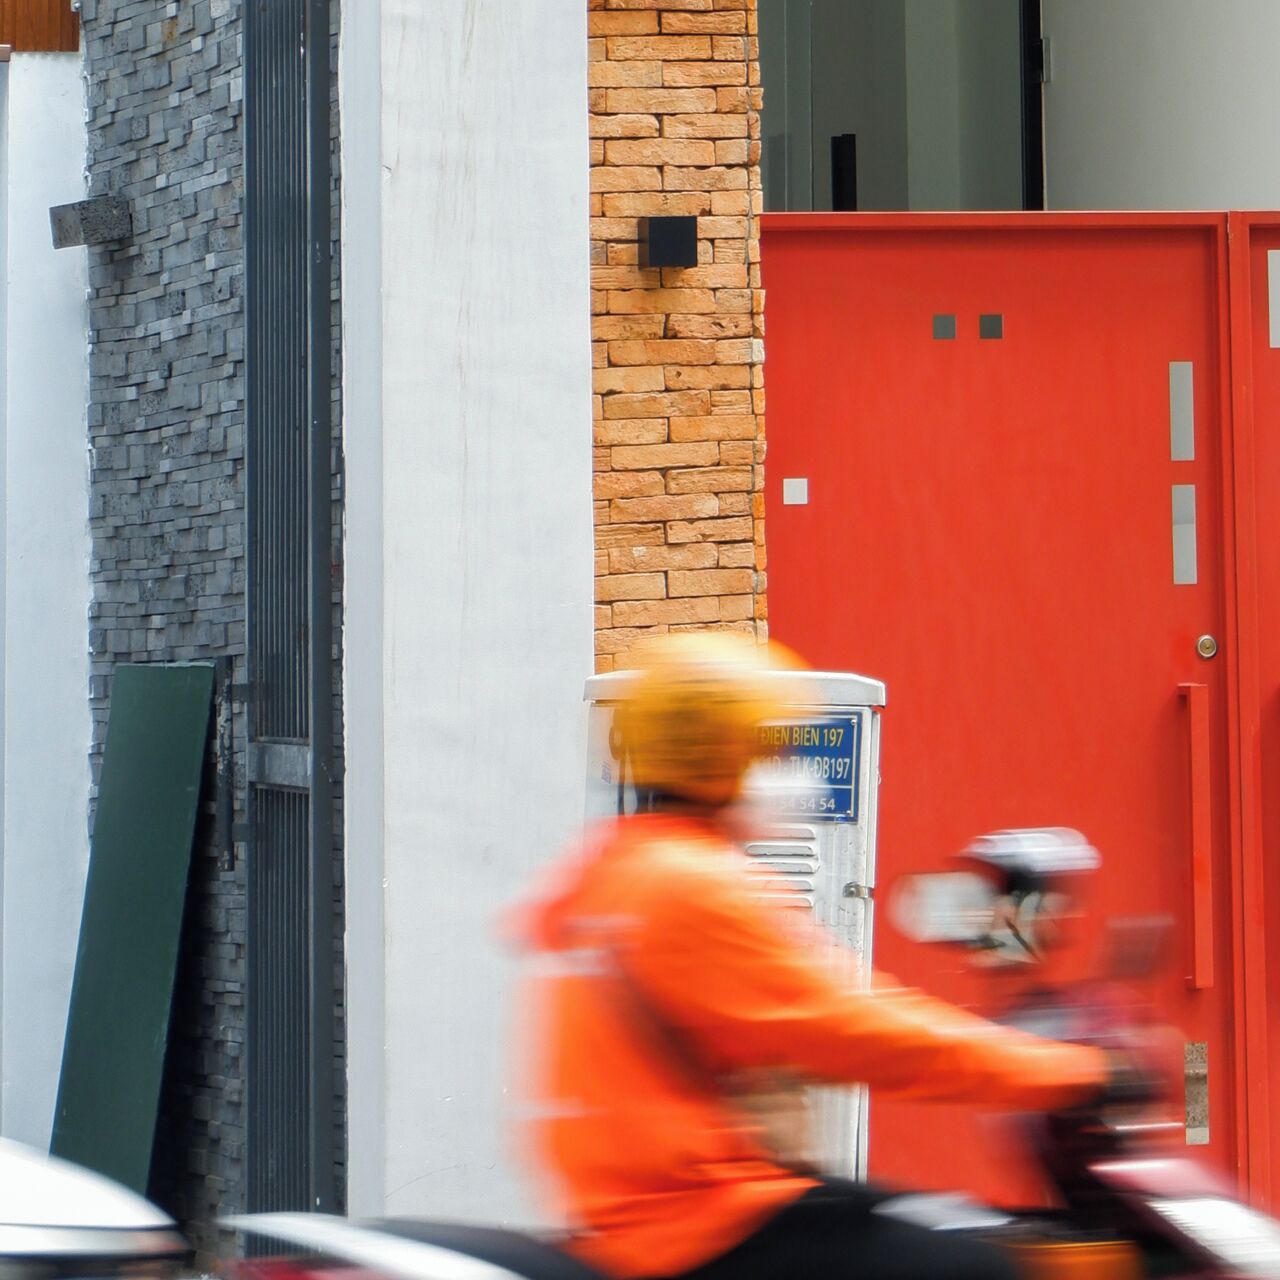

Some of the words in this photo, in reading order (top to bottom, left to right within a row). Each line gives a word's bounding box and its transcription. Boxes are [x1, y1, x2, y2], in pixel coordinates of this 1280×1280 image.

[792, 724, 819, 746] BIÊN
[823, 728, 844, 747] 197
[790, 756, 850, 779] TLK-ĐB197
[800, 798, 816, 810] 54
[819, 798, 836, 810] 54
